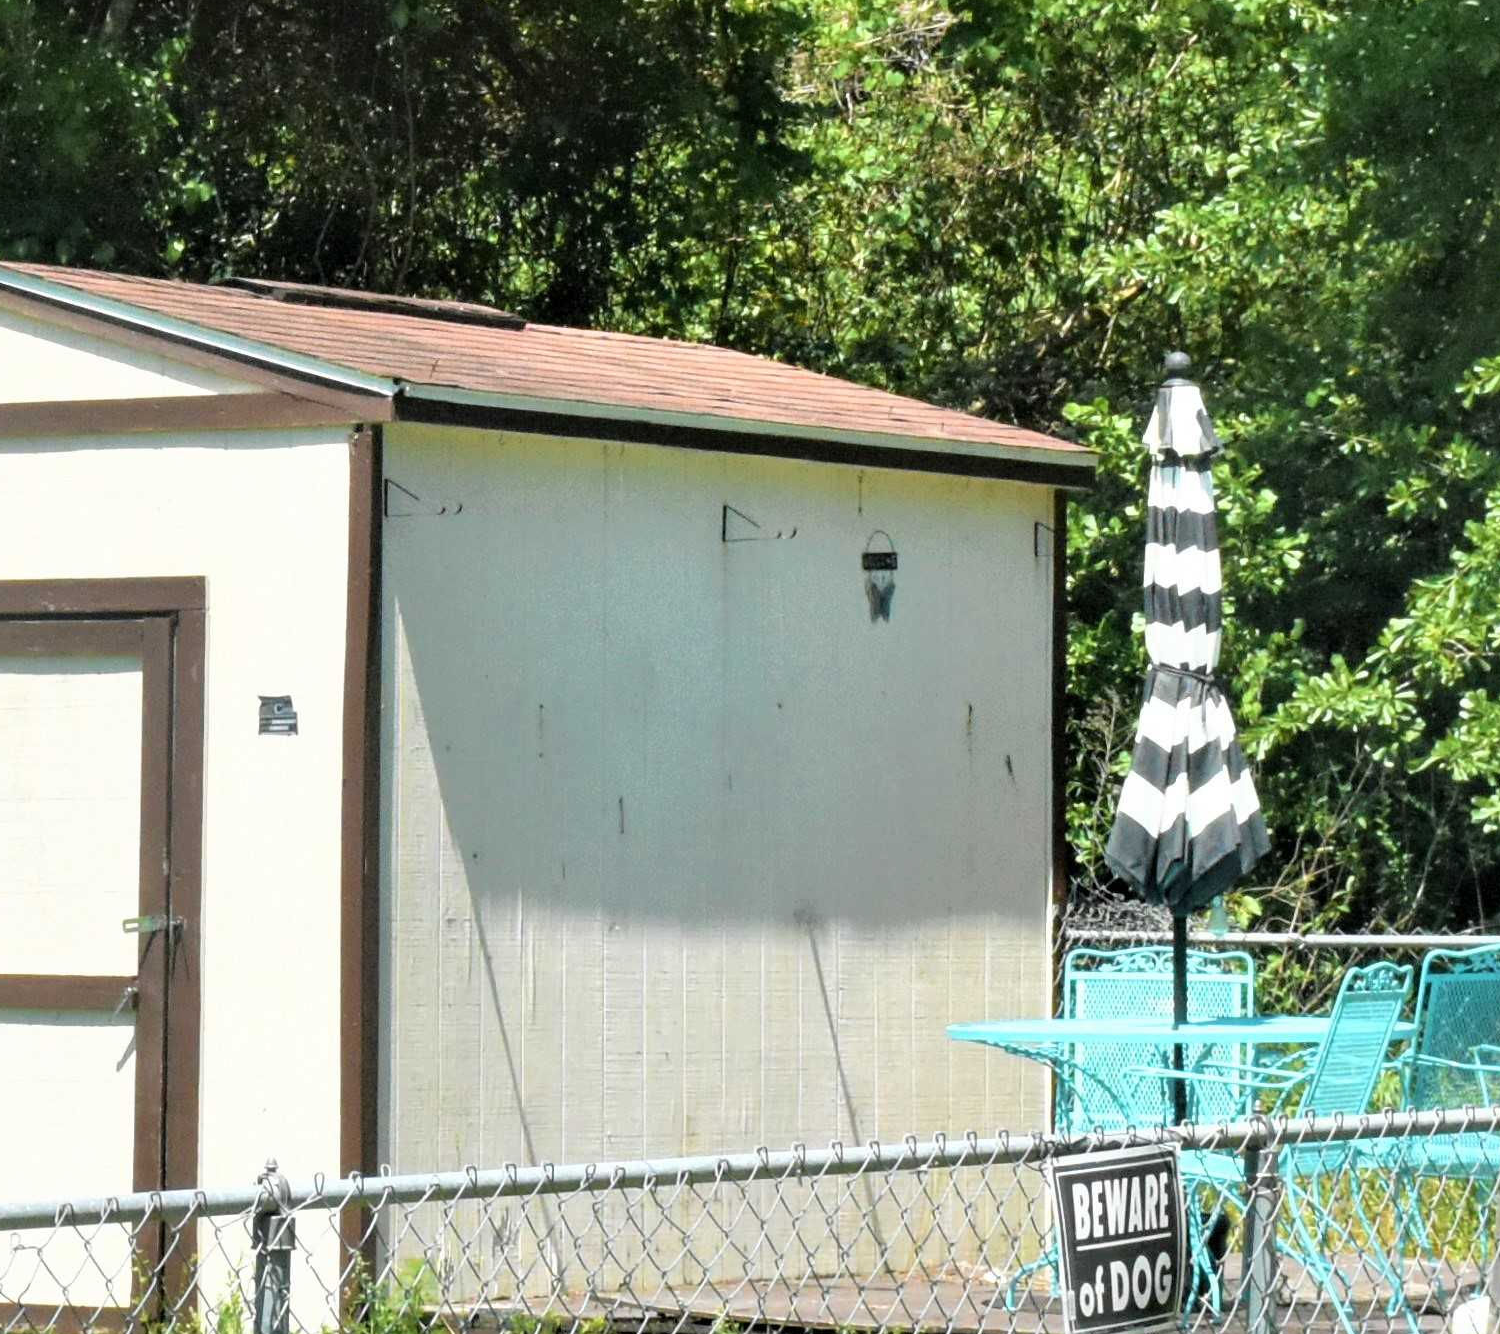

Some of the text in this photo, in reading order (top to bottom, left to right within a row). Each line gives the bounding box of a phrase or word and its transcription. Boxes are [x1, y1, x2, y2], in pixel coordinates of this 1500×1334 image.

[1072, 1172, 1169, 1240] BEWARE
[1080, 1252, 1172, 1317] of DOG
